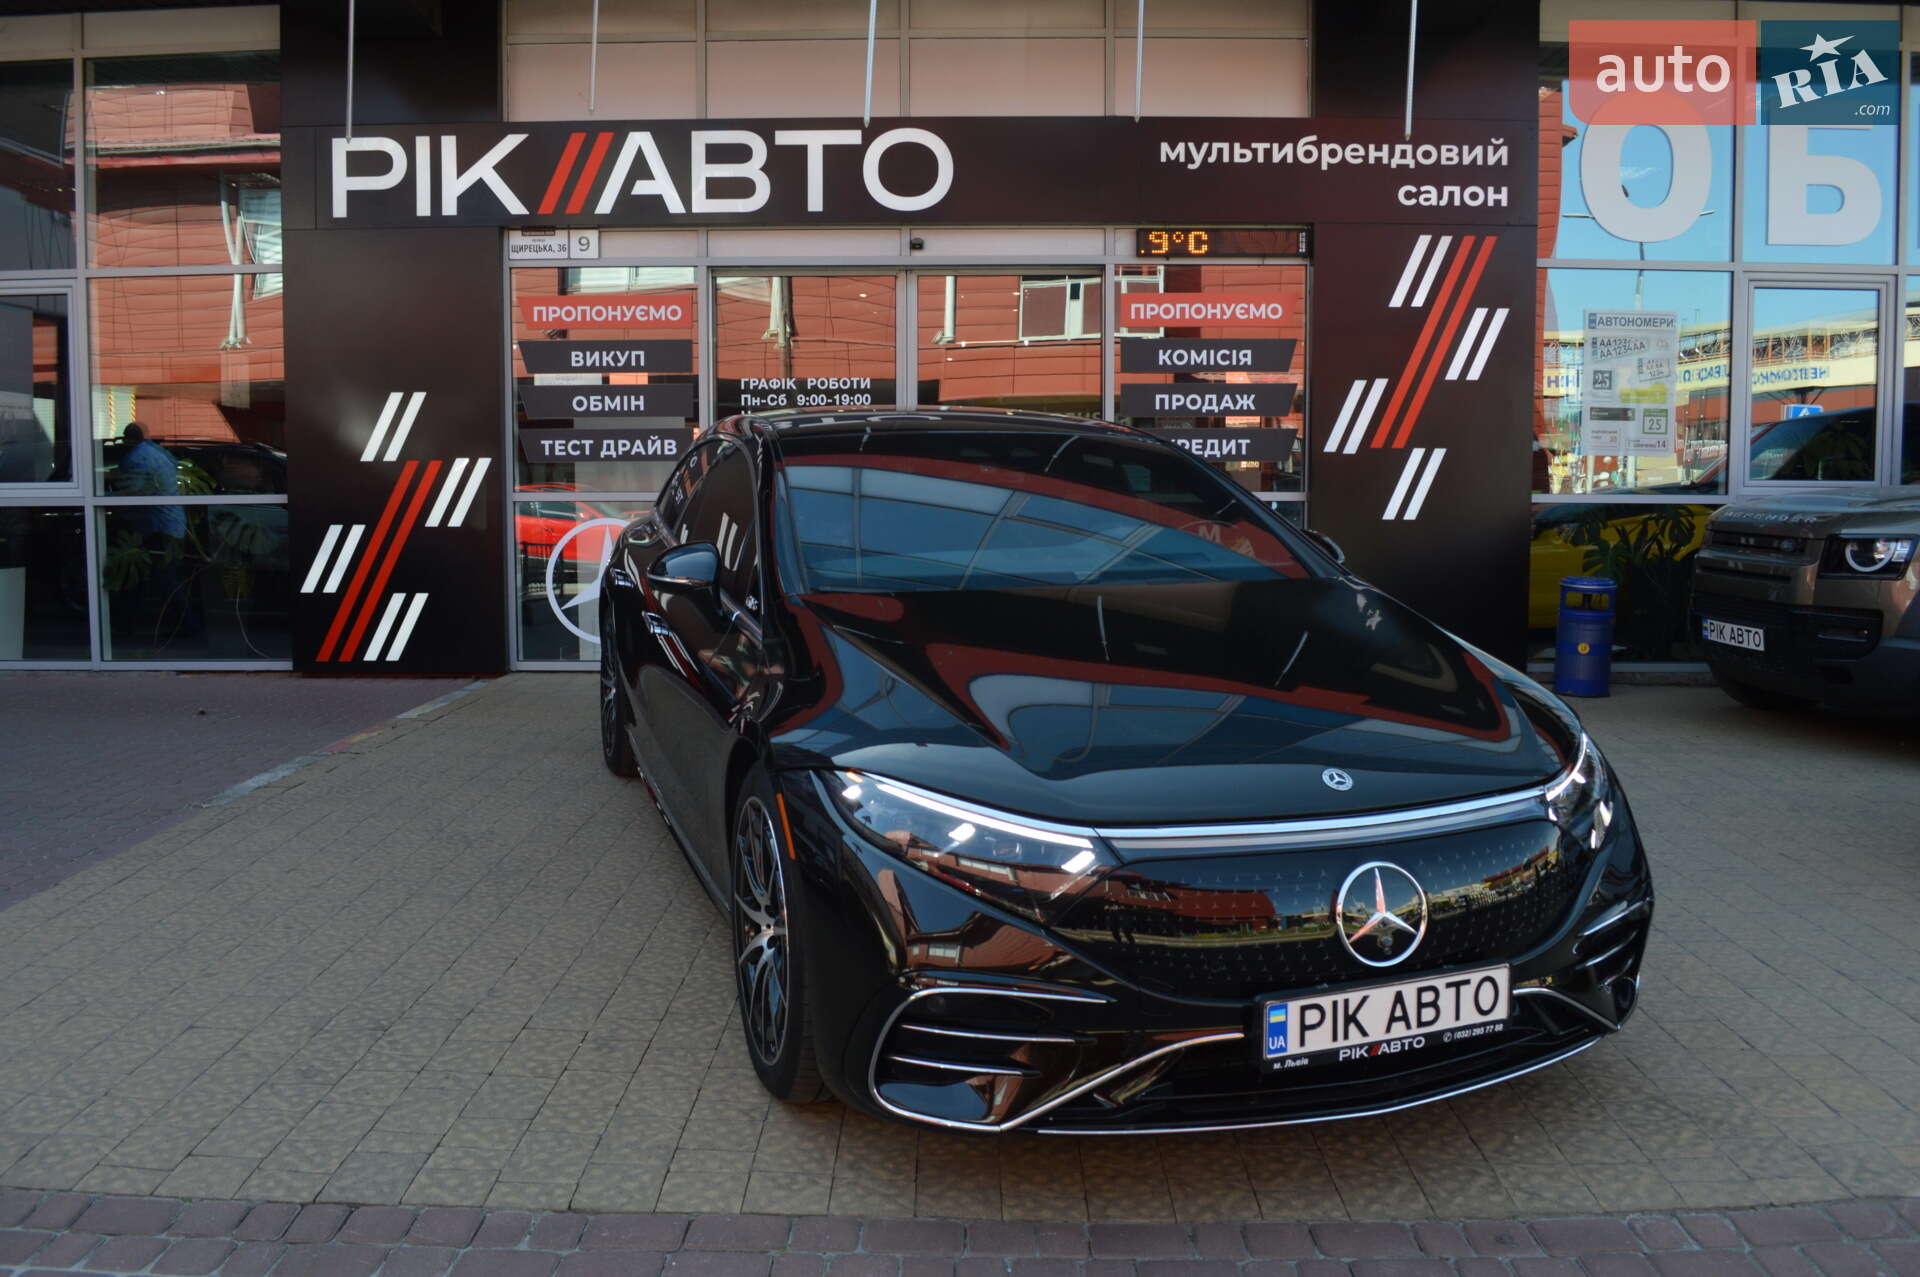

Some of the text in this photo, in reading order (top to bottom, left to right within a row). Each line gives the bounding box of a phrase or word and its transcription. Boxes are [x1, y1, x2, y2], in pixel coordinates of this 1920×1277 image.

[1159, 134, 1509, 171] мультибрендовий
[332, 126, 955, 219] РІК АВТО
[1397, 184, 1509, 207] салон
[577, 235, 591, 252] 9
[532, 304, 683, 323] ПРОПОНУЄМО
[1130, 303, 1284, 320] ПРОПОНУЄМО
[1597, 316, 1675, 328] АВТОНОМЕРИ
[570, 350, 646, 367] ВИКУП
[1158, 349, 1253, 366] КОМІСІЯ
[740, 377, 871, 390] ГРАФІК РОБОТИ
[572, 395, 645, 412] ОБМІН
[740, 393, 872, 406] Пн-Сб 9:00-19:00
[1154, 394, 1257, 411] ПРОДАЖ
[1648, 418, 1662, 431] 25
[540, 435, 678, 458] ТЕСТ ДРАЙВ
[1171, 438, 1251, 458] РЕДИТ
[1729, 626, 1762, 648] АВТО
[1299, 975, 1500, 1048] РІК АВТО
[1268, 1035, 1286, 1050] UA
[1379, 1036, 1425, 1056] АВТО
